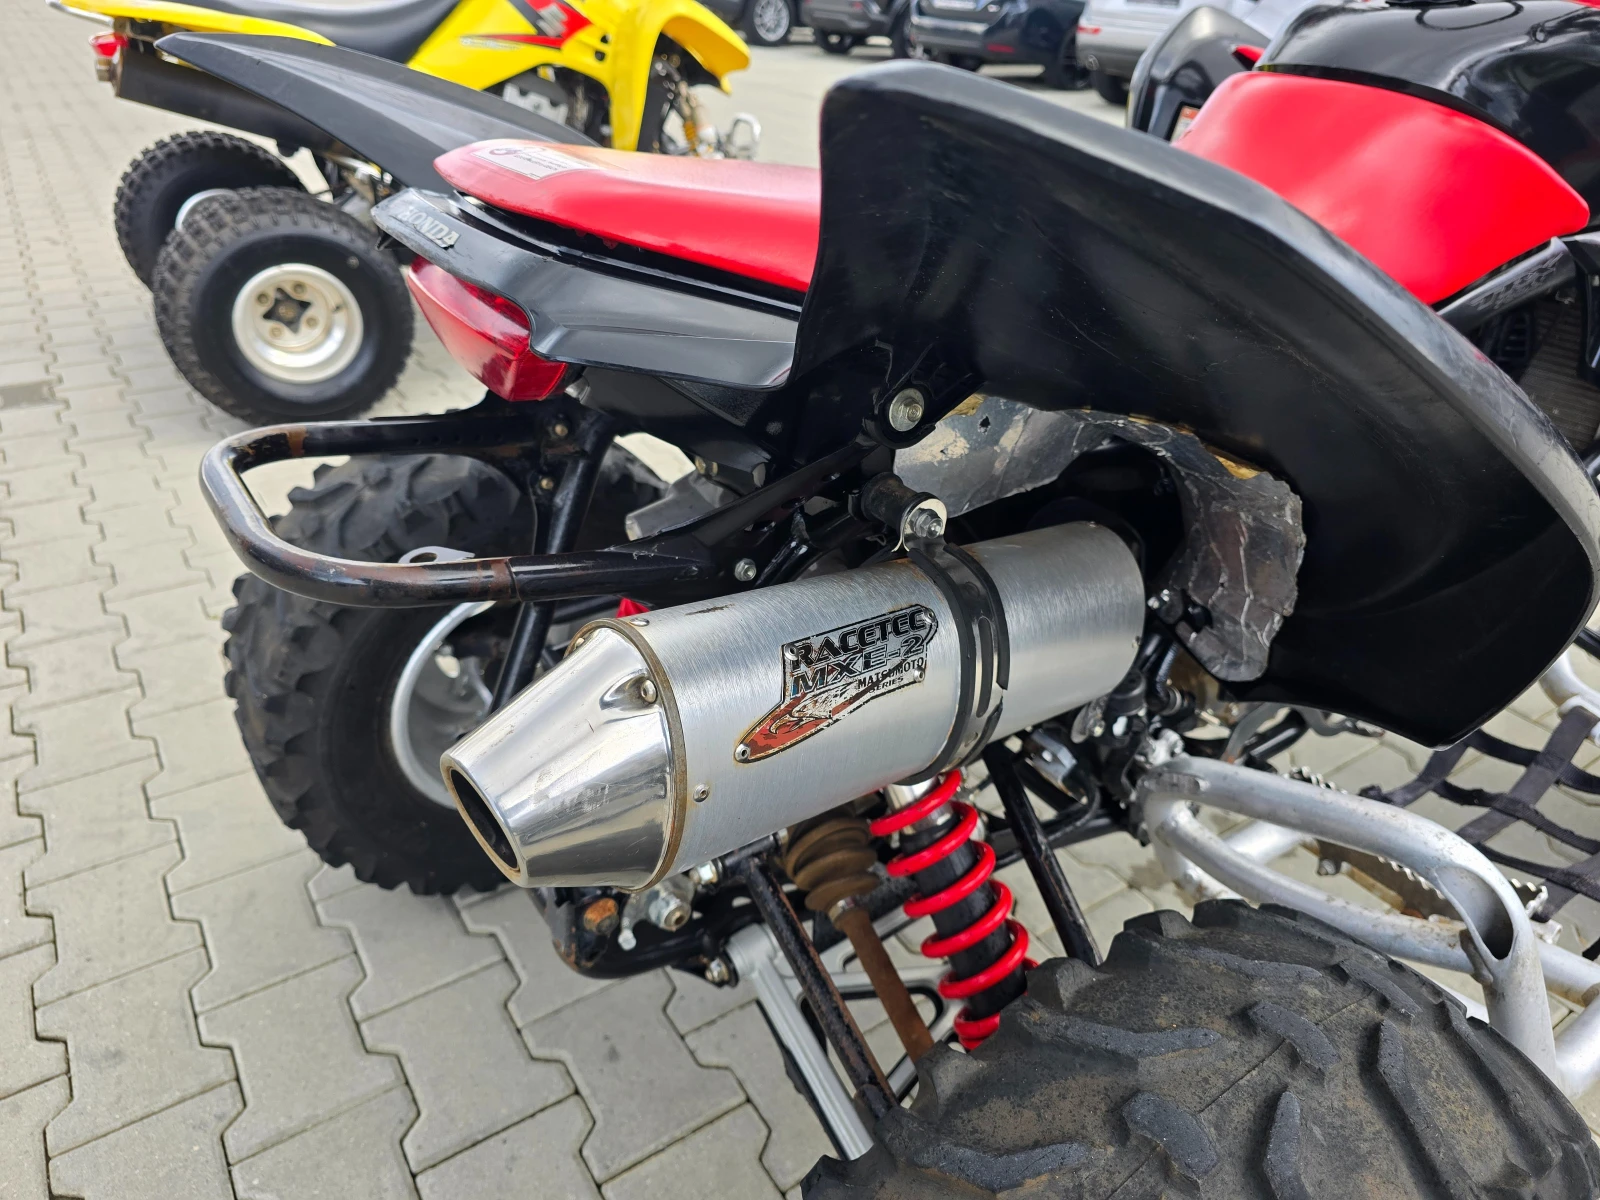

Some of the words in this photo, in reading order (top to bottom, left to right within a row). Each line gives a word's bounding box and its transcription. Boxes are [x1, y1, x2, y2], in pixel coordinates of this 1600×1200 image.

[395, 206, 460, 247] HONDA
[790, 635, 925, 697] MXE-2
[791, 610, 927, 670] RACETEC
